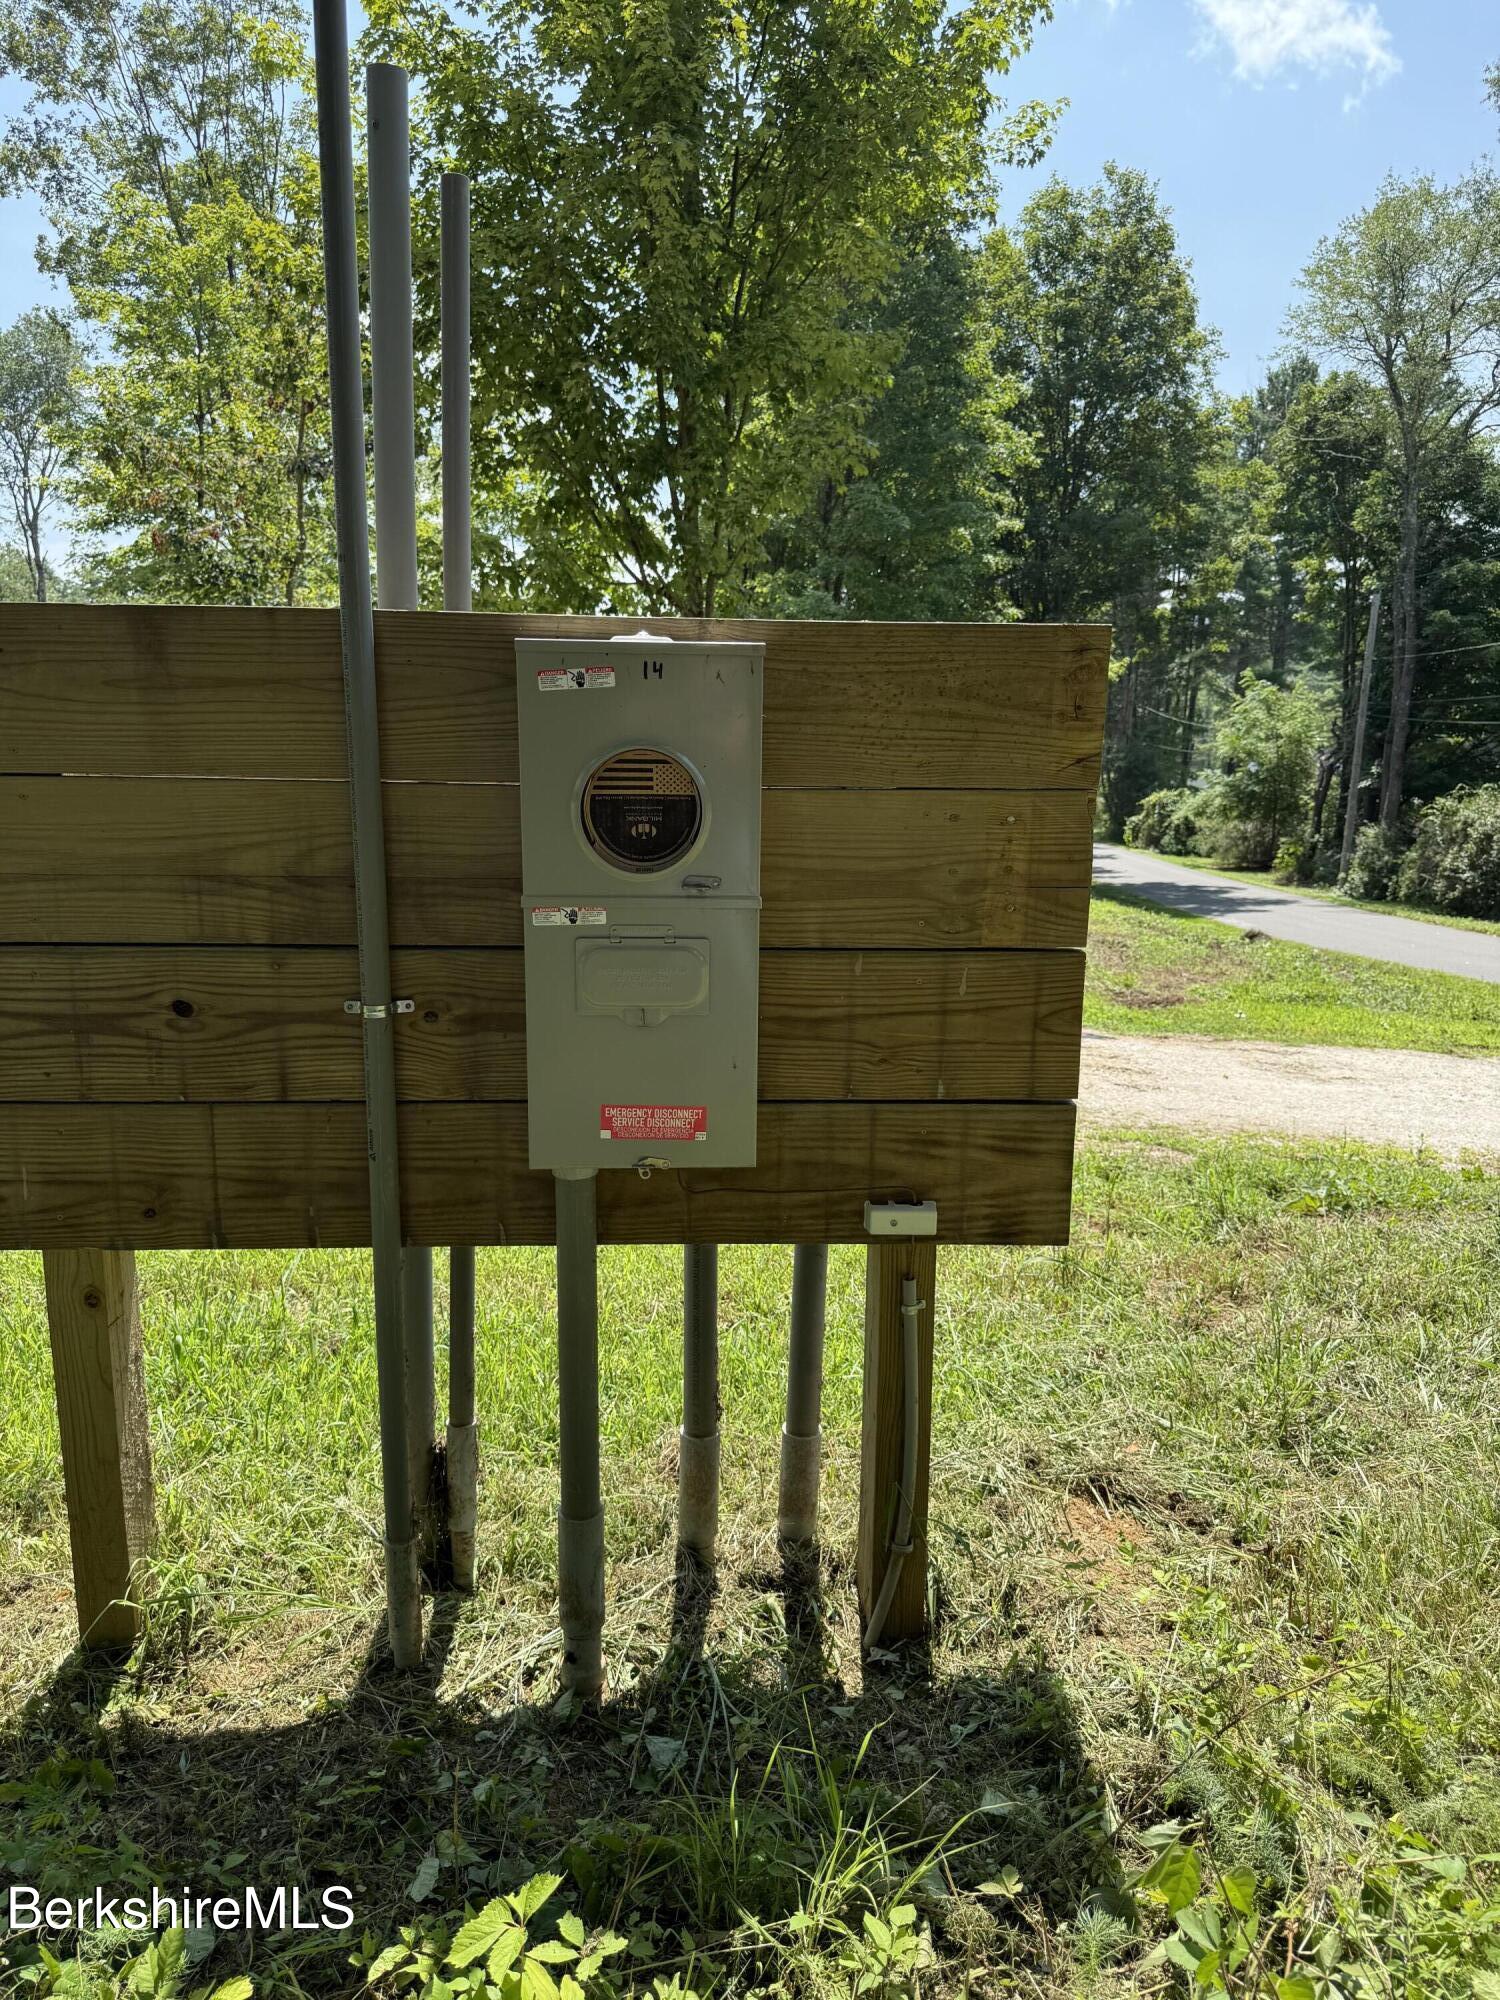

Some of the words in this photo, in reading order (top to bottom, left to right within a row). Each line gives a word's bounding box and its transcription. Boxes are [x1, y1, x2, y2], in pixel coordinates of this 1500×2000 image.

[643, 660, 663, 680] 14
[605, 1107, 652, 1118] EMERGENCY
[654, 1108, 703, 1119] DISCONNECT
[612, 1117, 645, 1127] SERVICE
[647, 1118, 695, 1128] DISCONNECT
